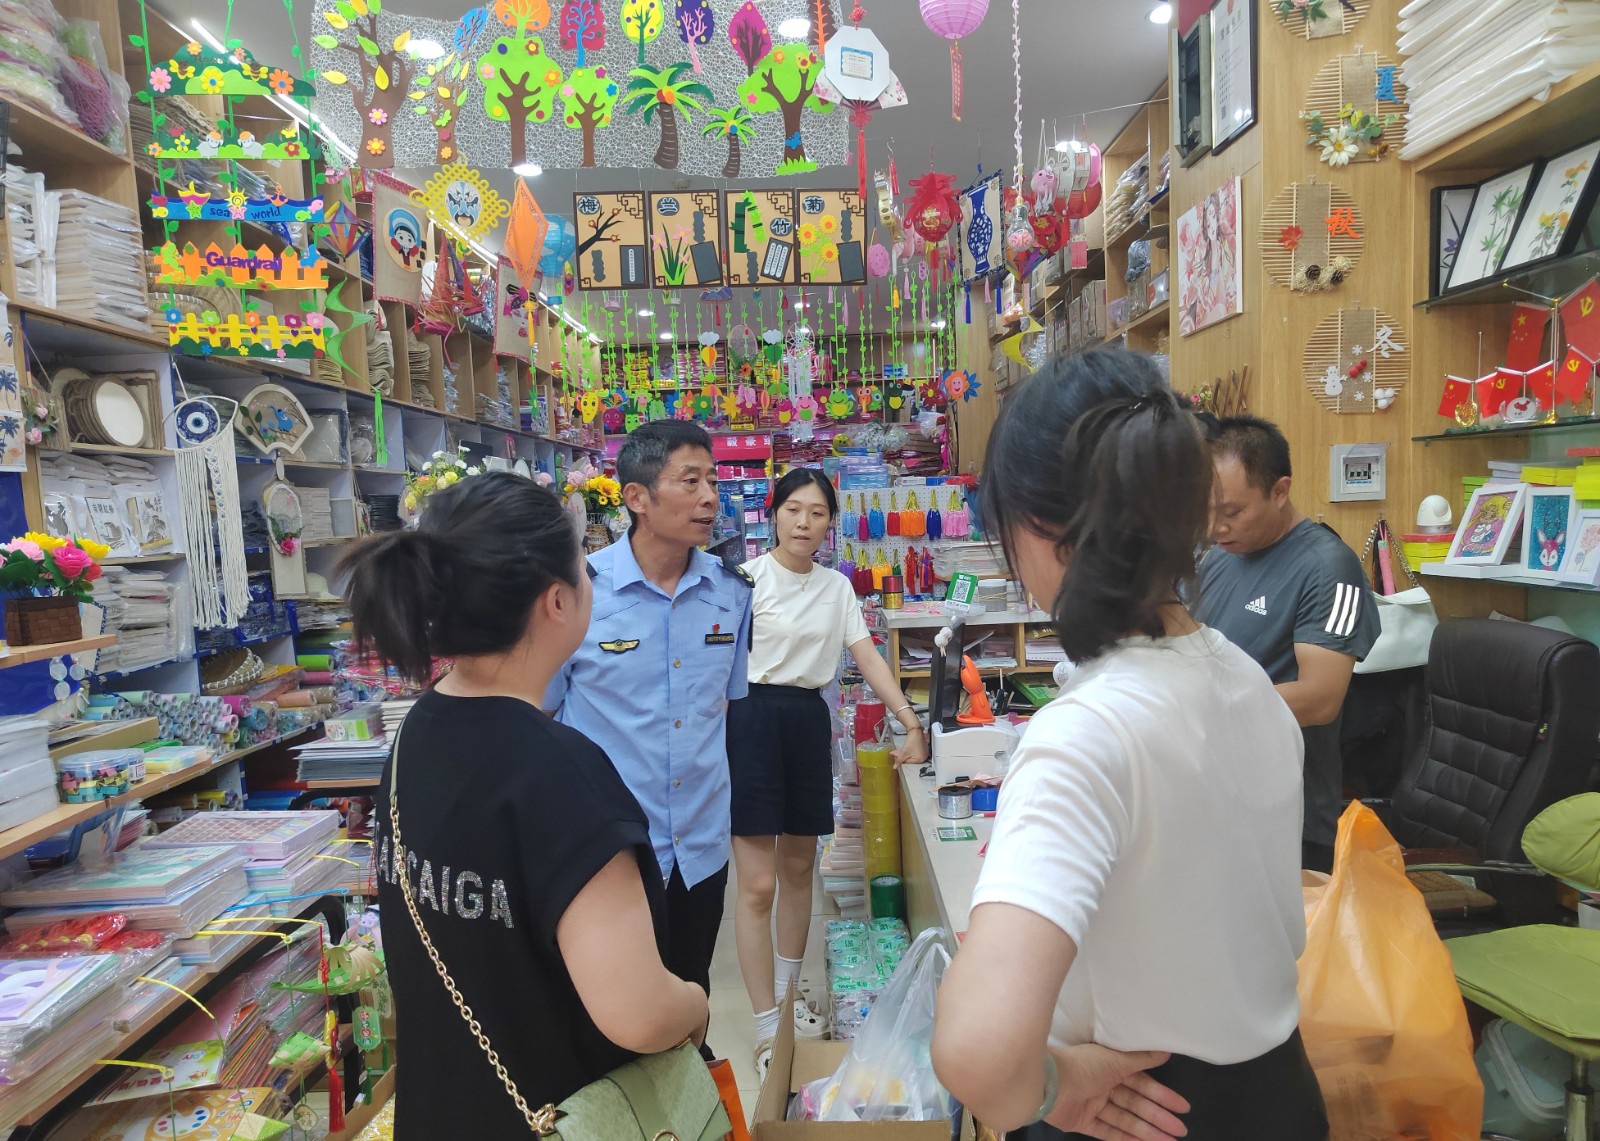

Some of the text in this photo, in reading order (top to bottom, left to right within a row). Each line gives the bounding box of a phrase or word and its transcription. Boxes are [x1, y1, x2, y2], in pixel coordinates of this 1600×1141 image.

[1375, 66, 1399, 104] 夏
[210, 206, 281, 219] sea world
[578, 197, 600, 213] 梅
[659, 197, 678, 213] 兰
[803, 196, 823, 213] 菊
[771, 219, 790, 235] 竹
[1324, 208, 1360, 238] 秋
[1366, 324, 1404, 358] 冬
[1245, 603, 1267, 616] adidas
